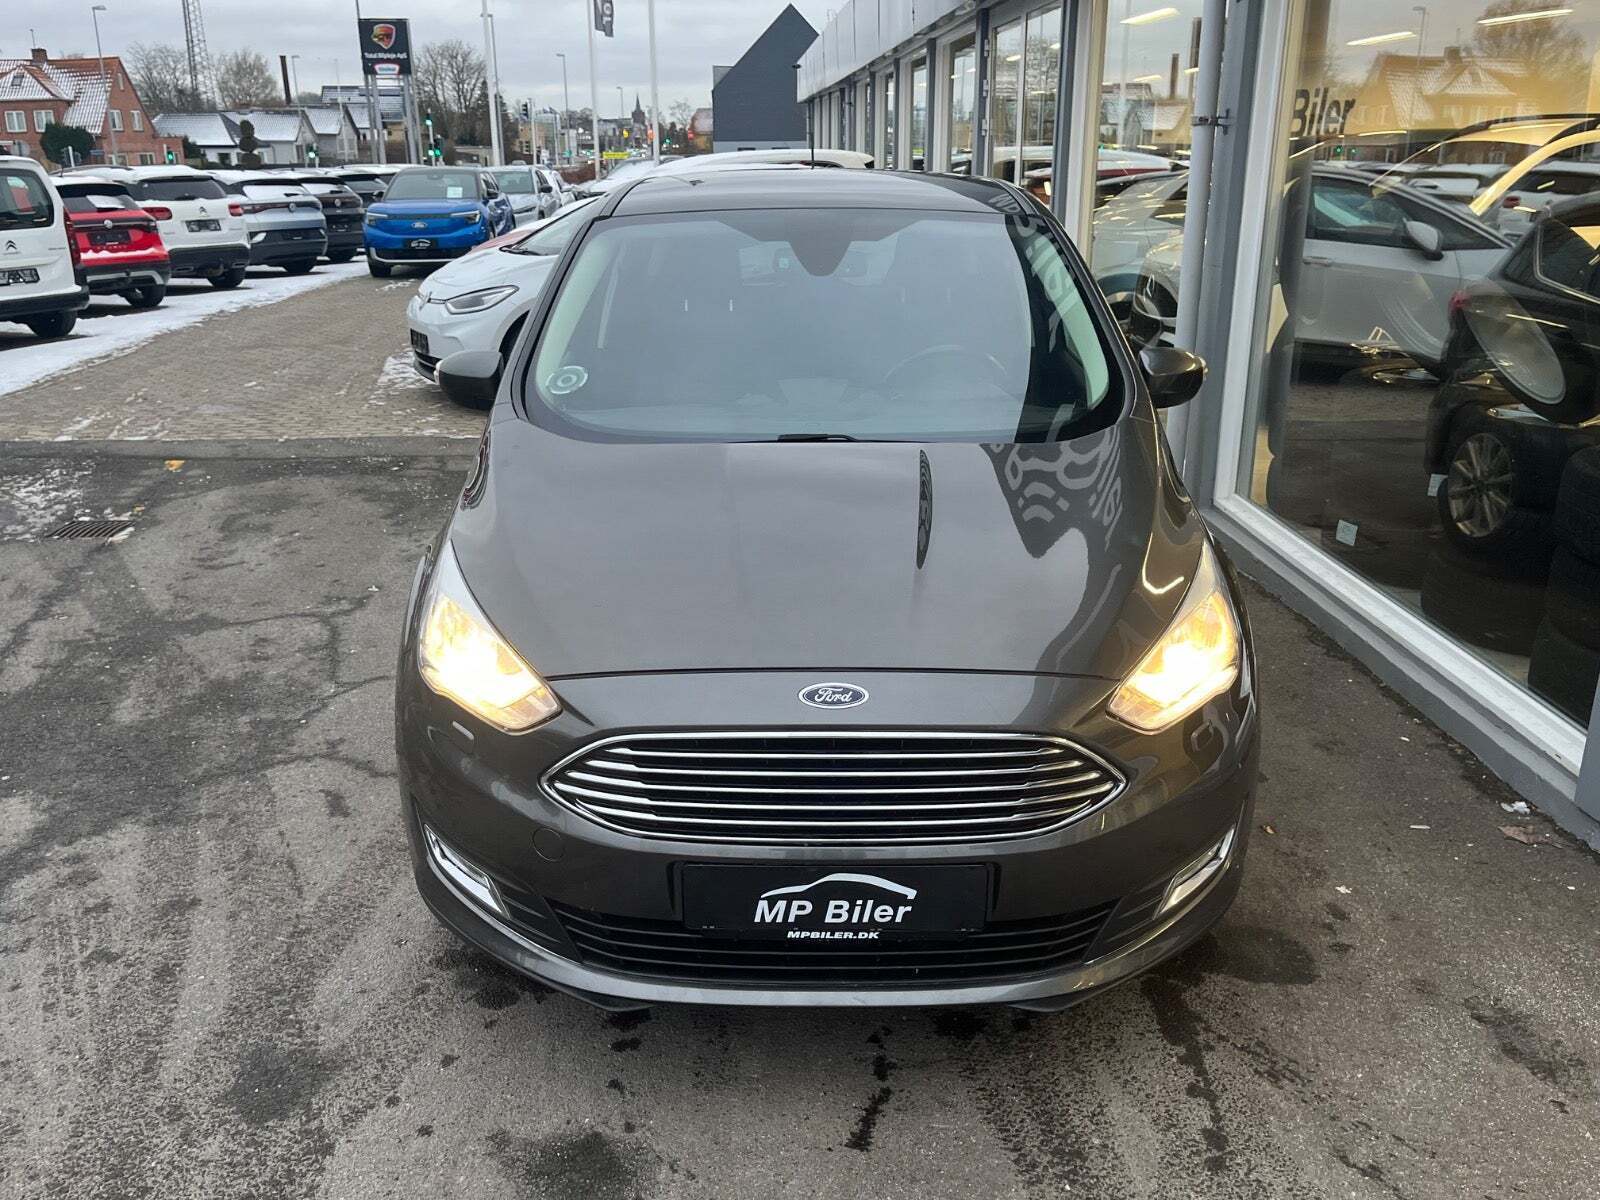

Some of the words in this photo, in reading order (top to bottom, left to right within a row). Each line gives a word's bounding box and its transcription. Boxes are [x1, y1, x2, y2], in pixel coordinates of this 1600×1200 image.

[1290, 87, 1356, 136] Biler
[814, 687, 853, 702] Ford
[754, 899, 813, 923] MP
[824, 899, 912, 923] Biler
[786, 931, 880, 939] MPBILER.DK
